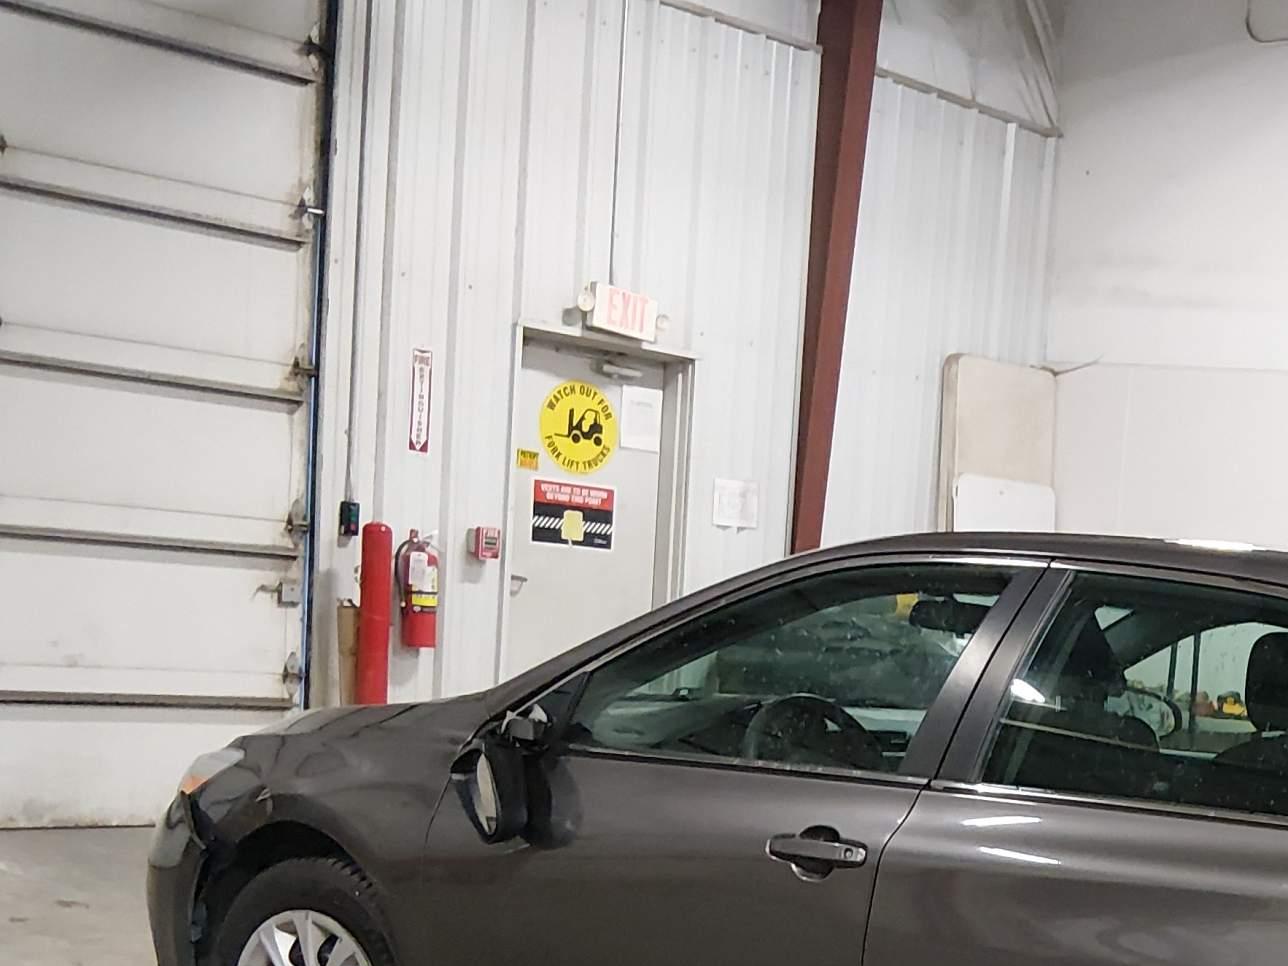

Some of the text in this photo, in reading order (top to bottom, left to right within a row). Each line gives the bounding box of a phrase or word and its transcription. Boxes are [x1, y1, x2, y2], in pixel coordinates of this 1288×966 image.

[607, 288, 649, 333] EXIT
[546, 384, 613, 421] WATCH OUT FOR
[545, 434, 563, 455] FORK
[562, 456, 580, 471] LIFT
[582, 444, 611, 471] TRUCKS
